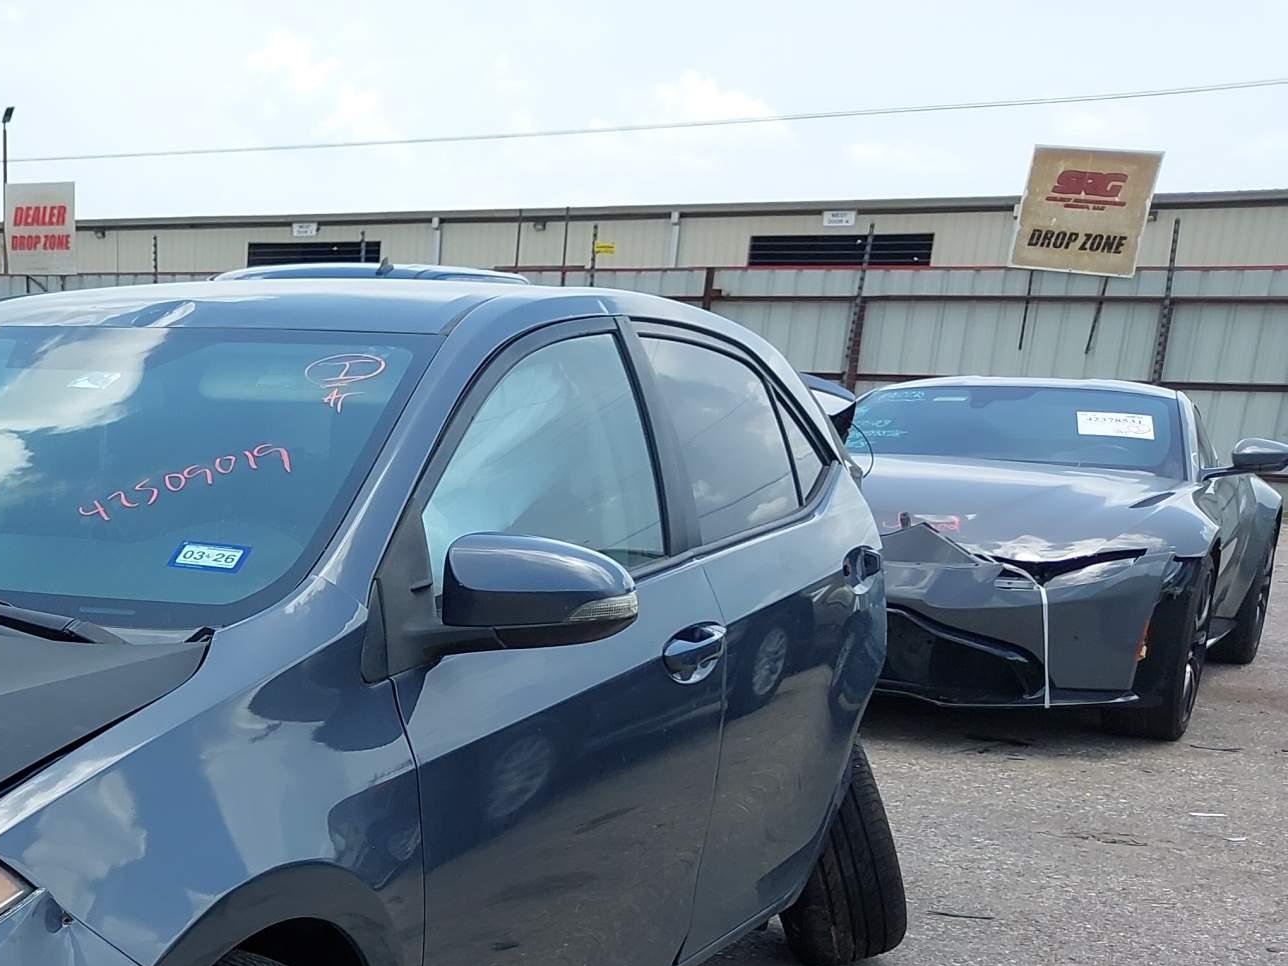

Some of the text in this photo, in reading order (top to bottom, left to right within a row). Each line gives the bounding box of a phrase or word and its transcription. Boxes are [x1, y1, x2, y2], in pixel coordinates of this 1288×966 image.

[13, 205, 66, 227] DEALER
[11, 234, 71, 251] DROP ZONE
[1027, 229, 1128, 255] DROP ZONE
[78, 442, 293, 521] 42509019
